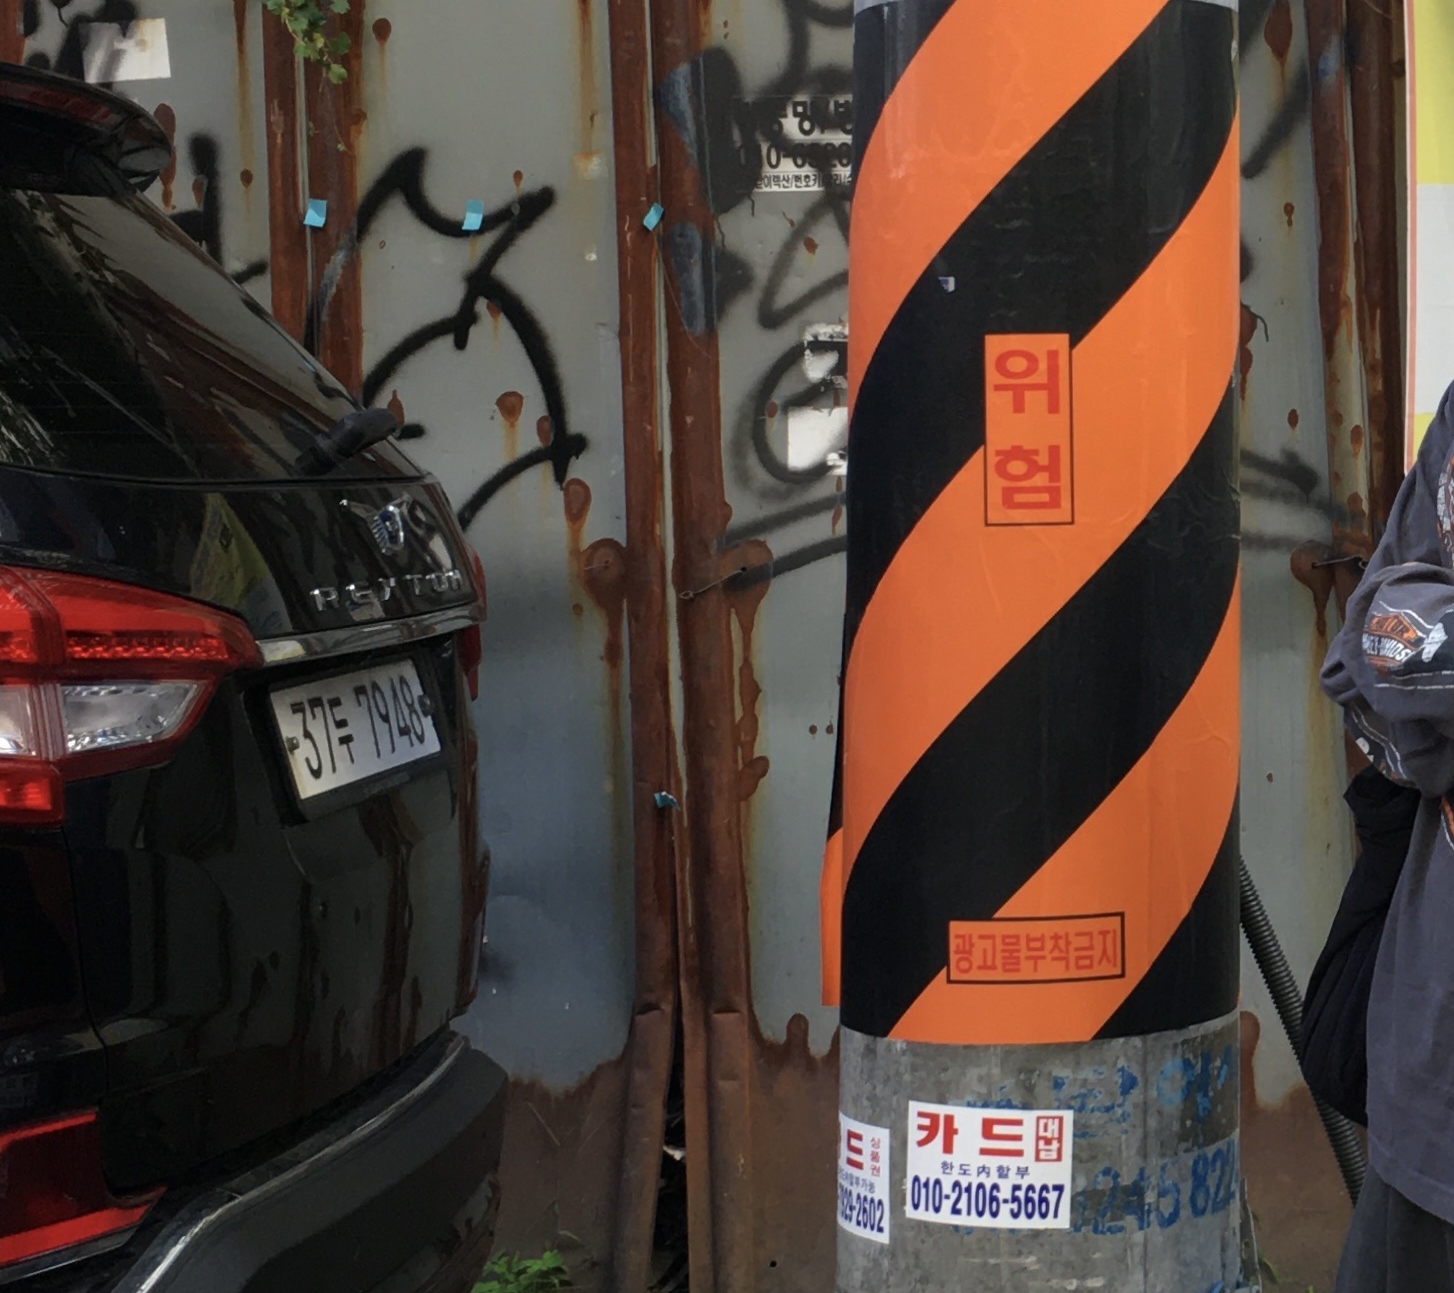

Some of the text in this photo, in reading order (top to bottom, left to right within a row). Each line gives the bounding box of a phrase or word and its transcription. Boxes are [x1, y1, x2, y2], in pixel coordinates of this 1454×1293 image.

[993, 349, 1063, 511] 위험
[353, 674, 426, 759] 7948
[953, 928, 1119, 975] 광고물부착금지
[845, 1128, 864, 1171] 드
[916, 1110, 1025, 1158] 카드
[1037, 1117, 1061, 1160] 대납
[911, 1174, 1065, 1220] 010-2106-5667
